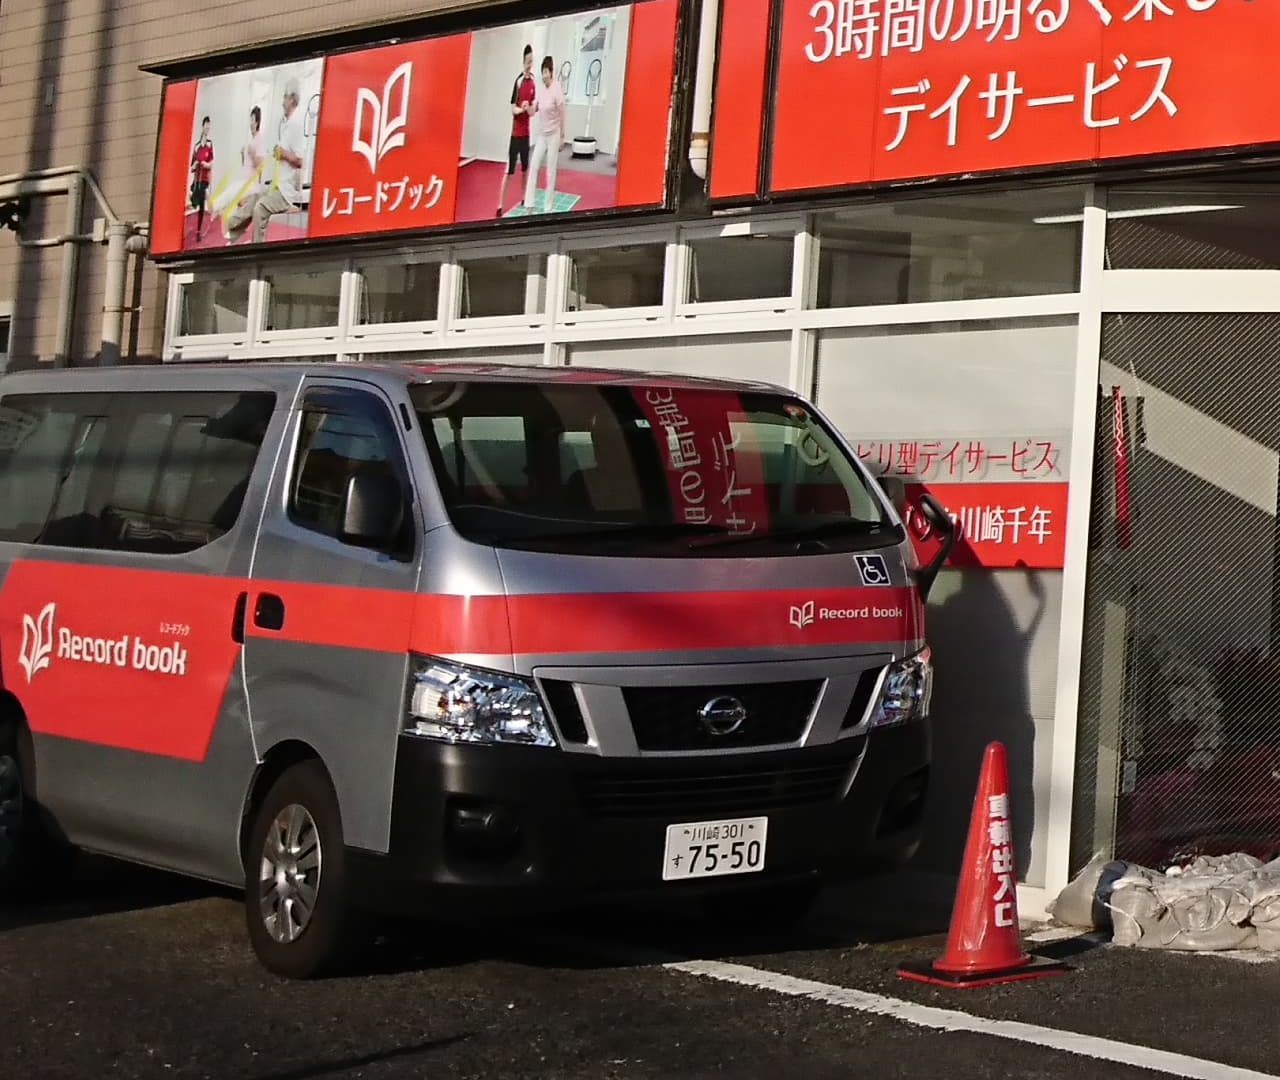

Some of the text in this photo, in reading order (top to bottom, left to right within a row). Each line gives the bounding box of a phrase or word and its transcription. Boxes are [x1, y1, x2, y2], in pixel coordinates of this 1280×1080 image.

[882, 52, 1179, 152] デイサービス
[322, 174, 444, 218] レコードブック
[819, 606, 903, 620] Record book
[58, 627, 188, 675] Record book
[691, 824, 744, 841] 川崎 301
[689, 840, 761, 874] 75-50
